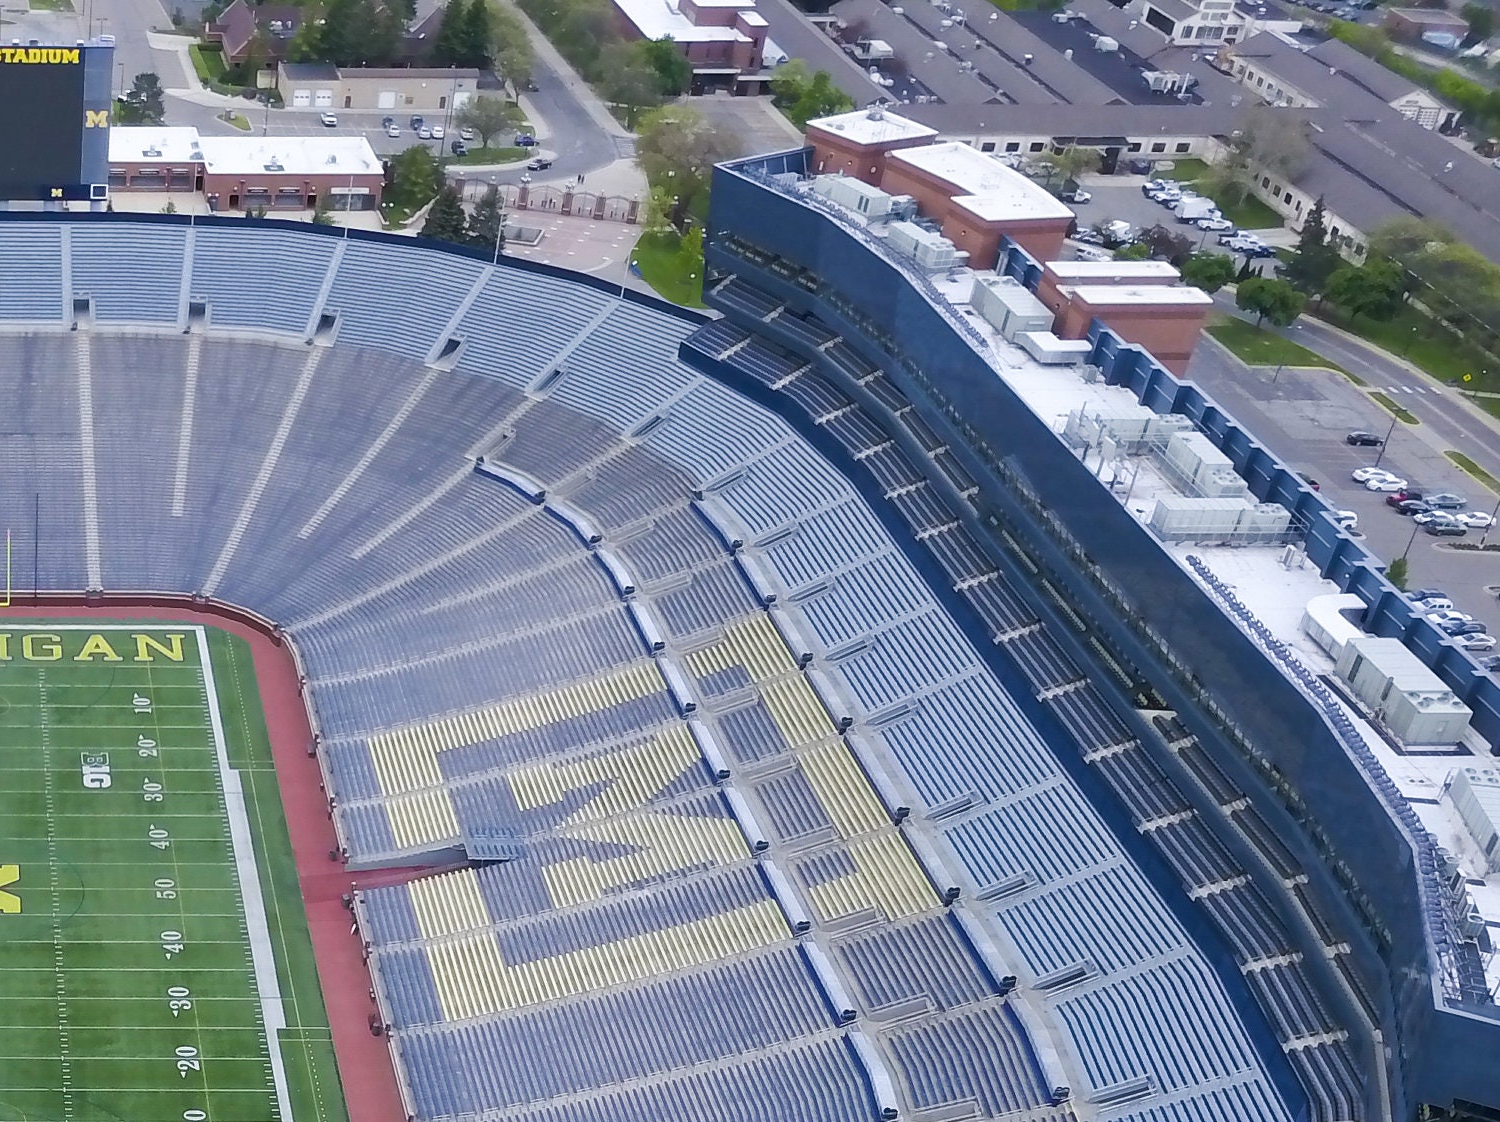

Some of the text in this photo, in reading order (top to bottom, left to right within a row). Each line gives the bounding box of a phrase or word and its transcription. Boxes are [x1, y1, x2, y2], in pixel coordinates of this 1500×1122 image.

[85, 110, 109, 128] M
[51, 188, 63, 198] M
[132, 697, 152, 714] 10
[137, 739, 158, 757] 20
[142, 782, 164, 802] 30
[148, 829, 170, 850] 40
[154, 878, 177, 900] 50
[160, 930, 184, 953] 40
[167, 986, 192, 1010] 30
[175, 1045, 200, 1071] 20
